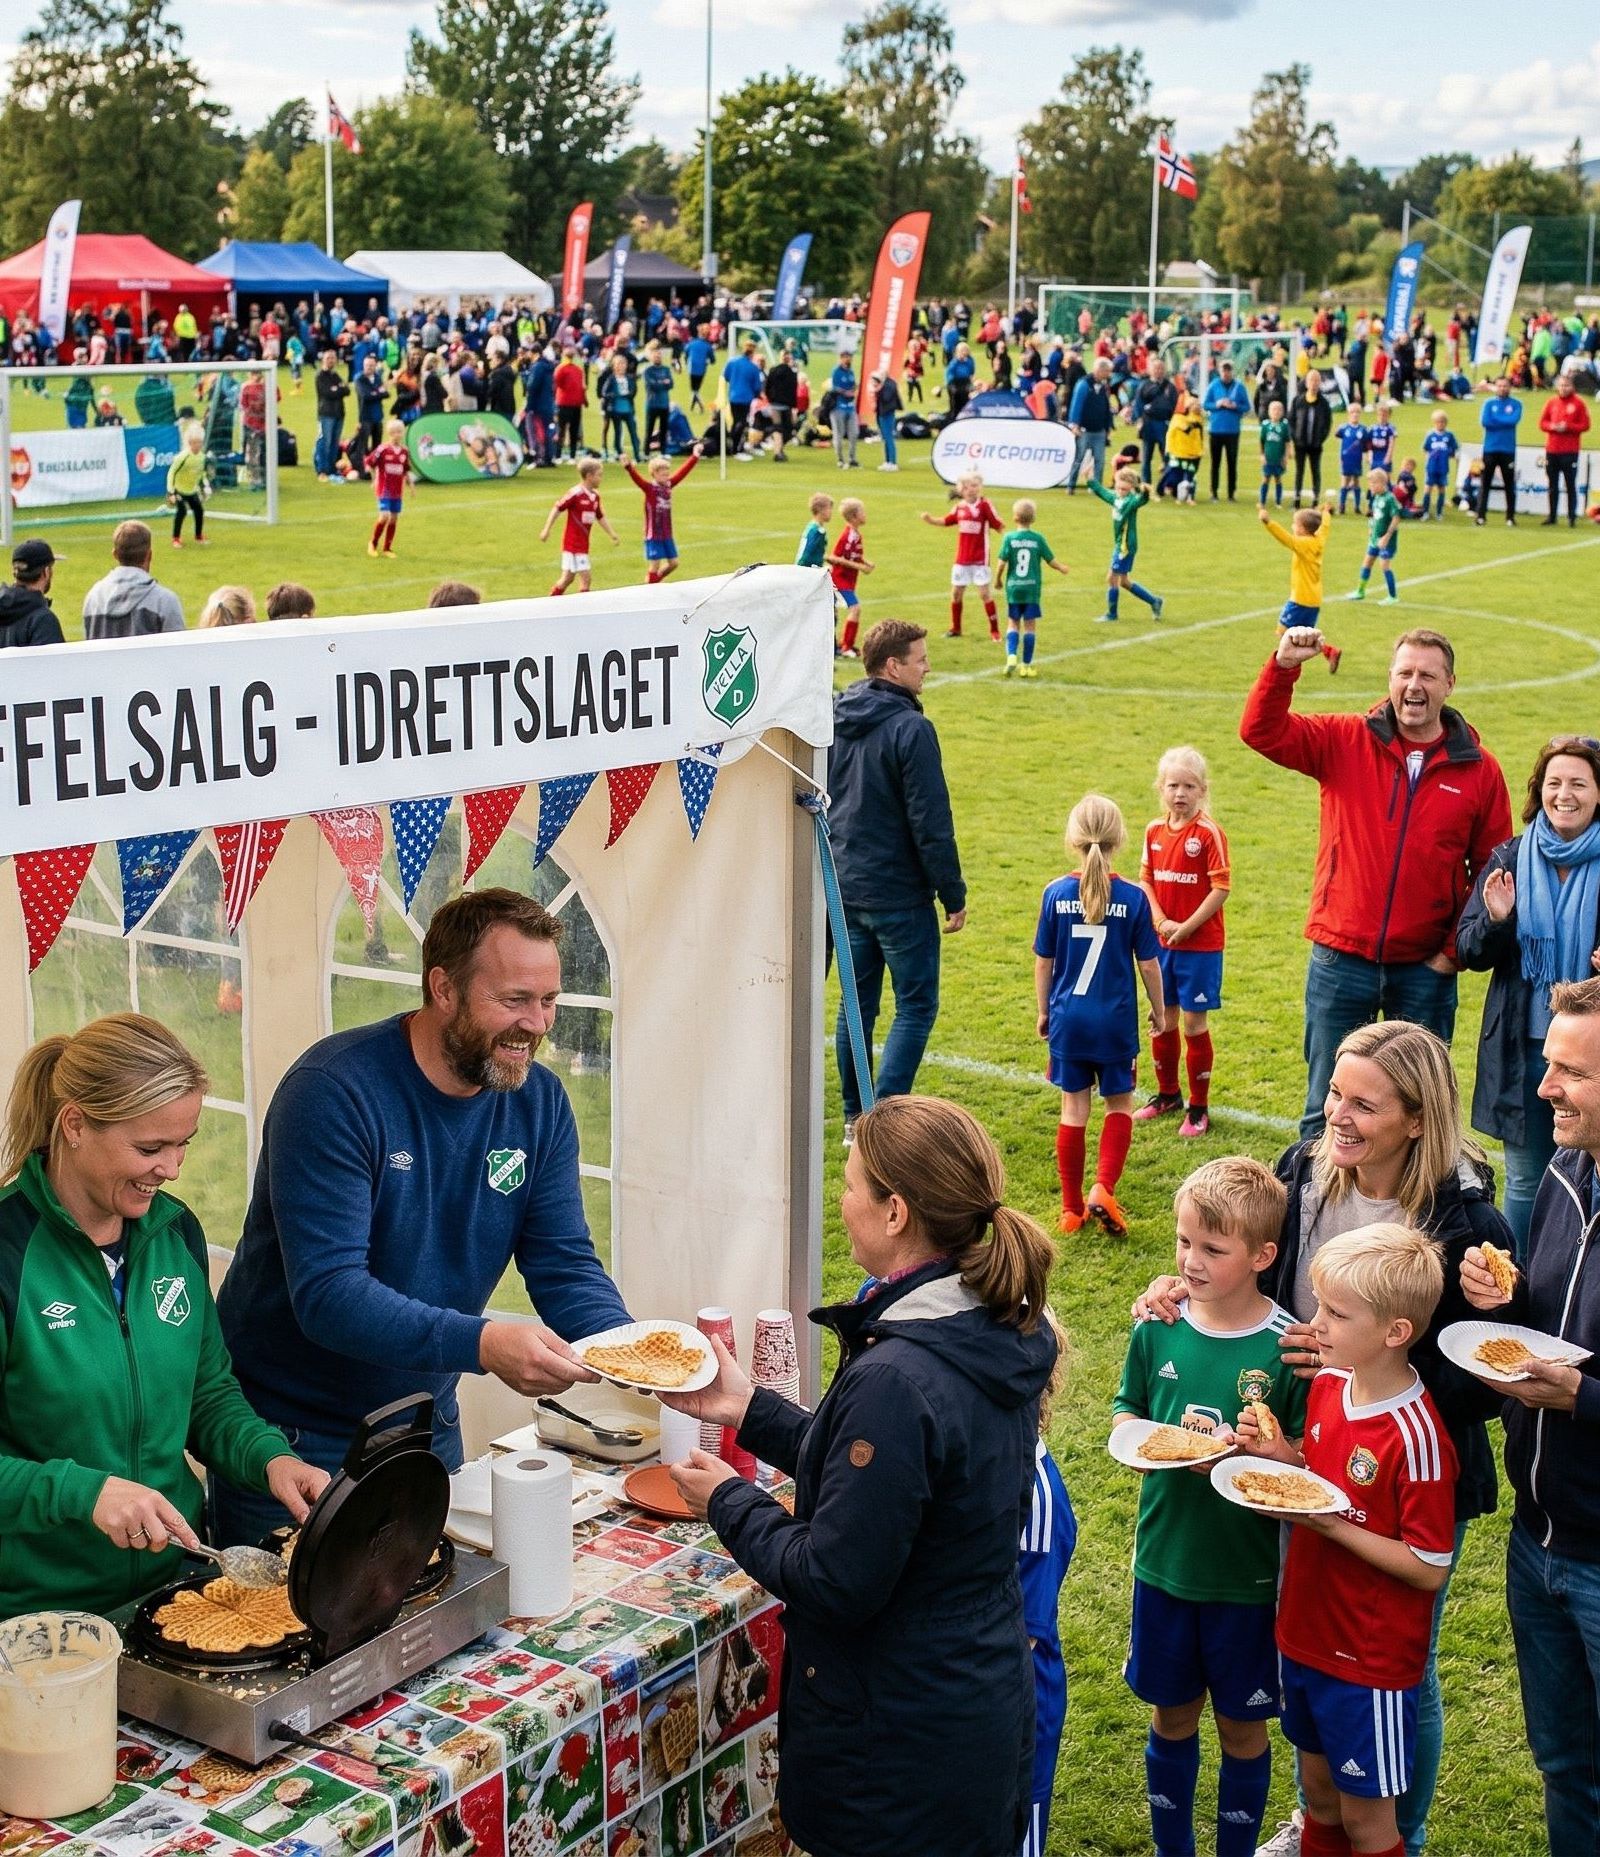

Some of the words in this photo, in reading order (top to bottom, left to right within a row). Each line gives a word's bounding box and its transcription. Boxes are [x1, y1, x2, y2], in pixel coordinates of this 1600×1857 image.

[1016, 549, 1030, 577] 8
[714, 641, 726, 660] C
[296, 715, 318, 731] -
[335, 645, 679, 766] IDRETTSLAGET
[733, 689, 744, 706] D
[1072, 924, 1107, 995] 7
